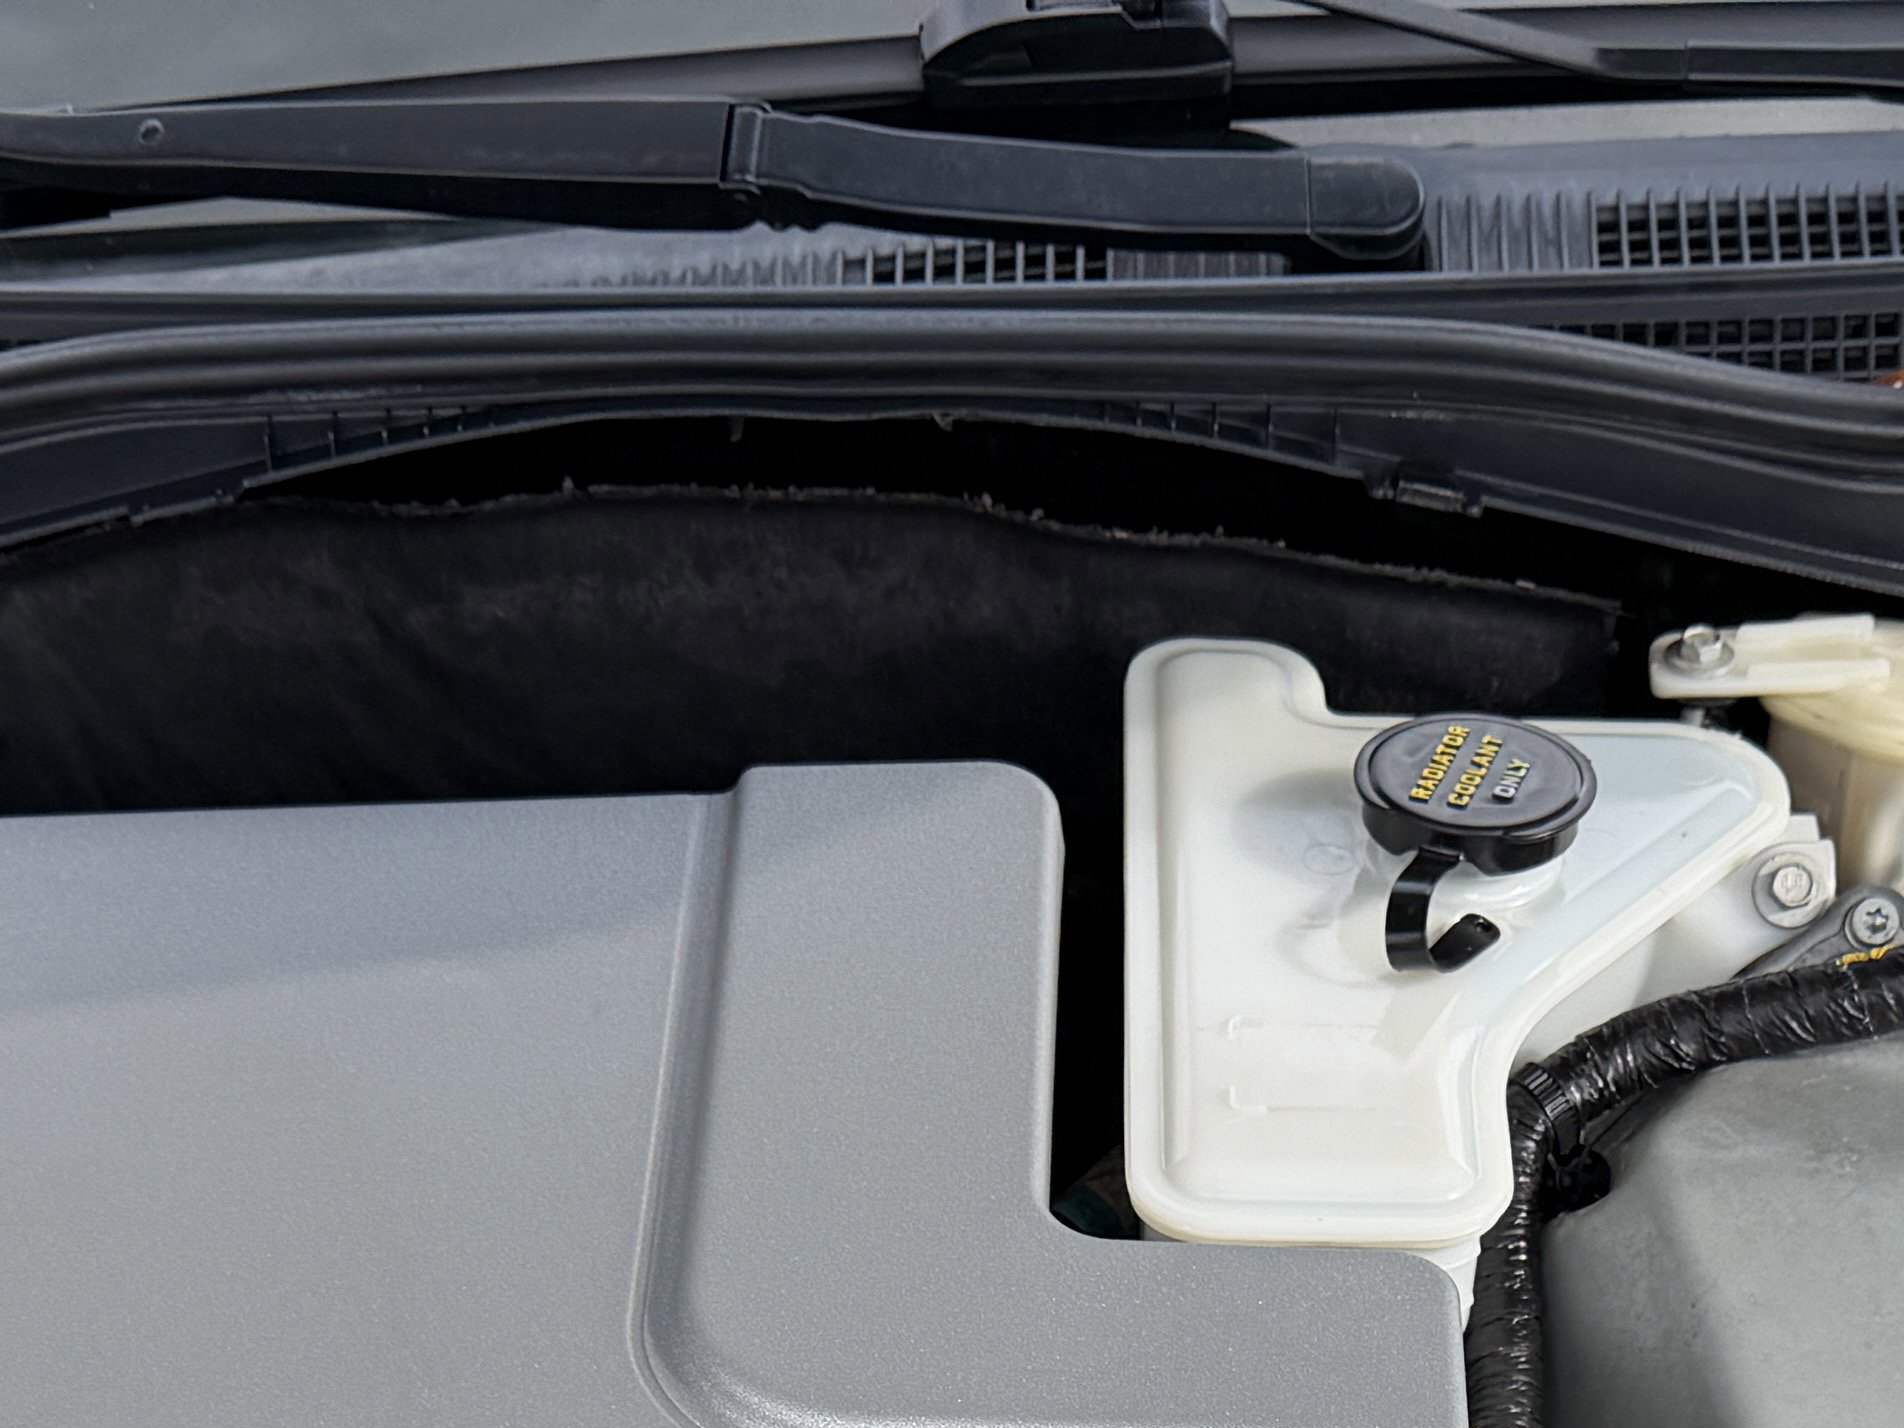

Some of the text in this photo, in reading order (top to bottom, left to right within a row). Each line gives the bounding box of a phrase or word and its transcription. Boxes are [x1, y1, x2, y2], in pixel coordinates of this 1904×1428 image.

[1411, 724, 1471, 800] RADIATOR
[1448, 734, 1504, 807] COOLANT
[1493, 759, 1531, 800] ONLY
